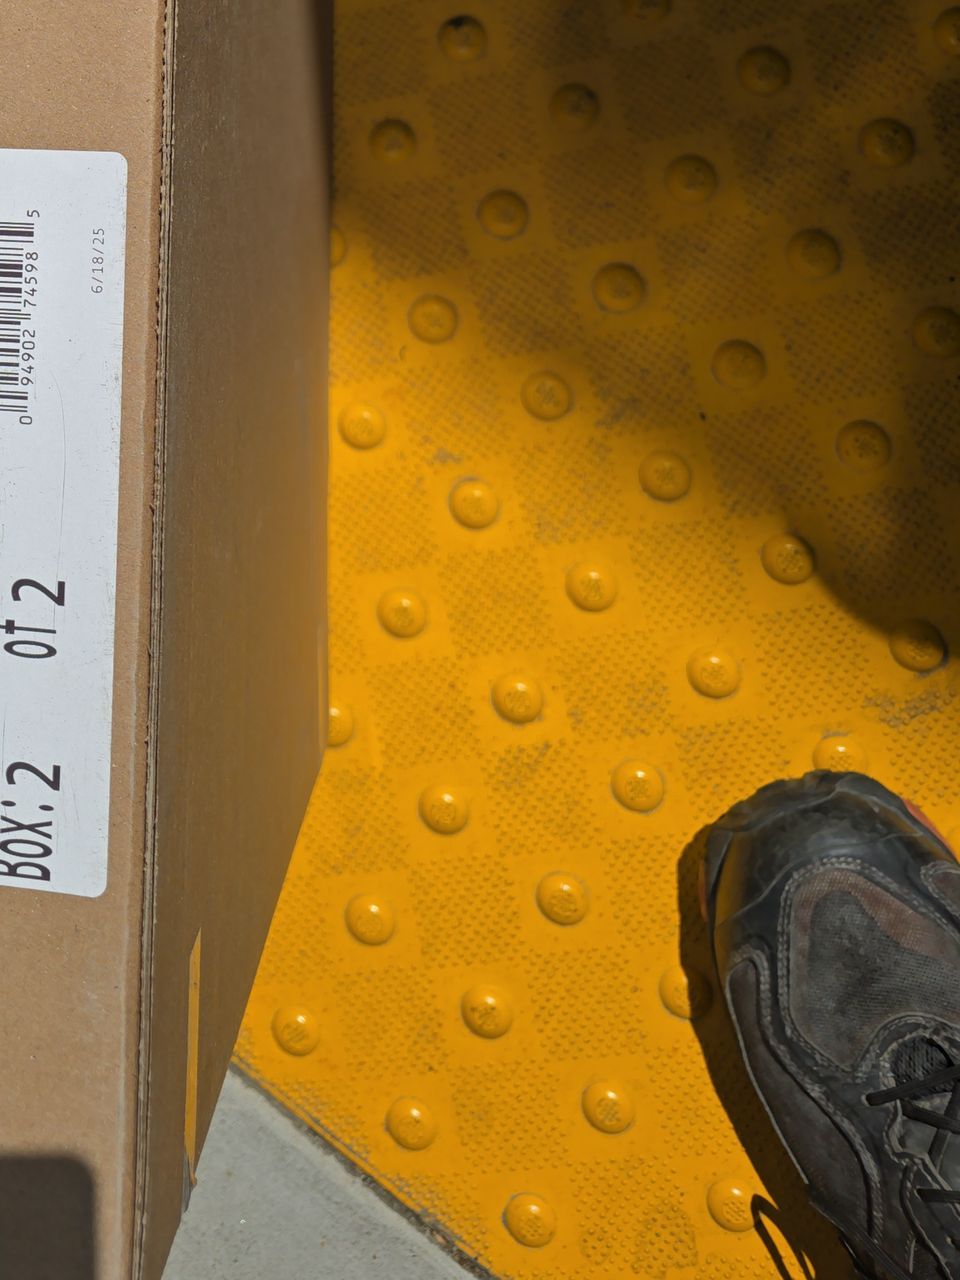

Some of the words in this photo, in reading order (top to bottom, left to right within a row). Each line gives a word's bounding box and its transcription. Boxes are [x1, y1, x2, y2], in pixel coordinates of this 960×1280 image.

[26, 209, 41, 218] 5
[90, 227, 106, 294] 6/18/25
[23, 250, 40, 308] 74598
[20, 329, 37, 386] 94902
[18, 416, 33, 425] 0
[12, 578, 66, 607] 2
[6, 761, 61, 791] 2
